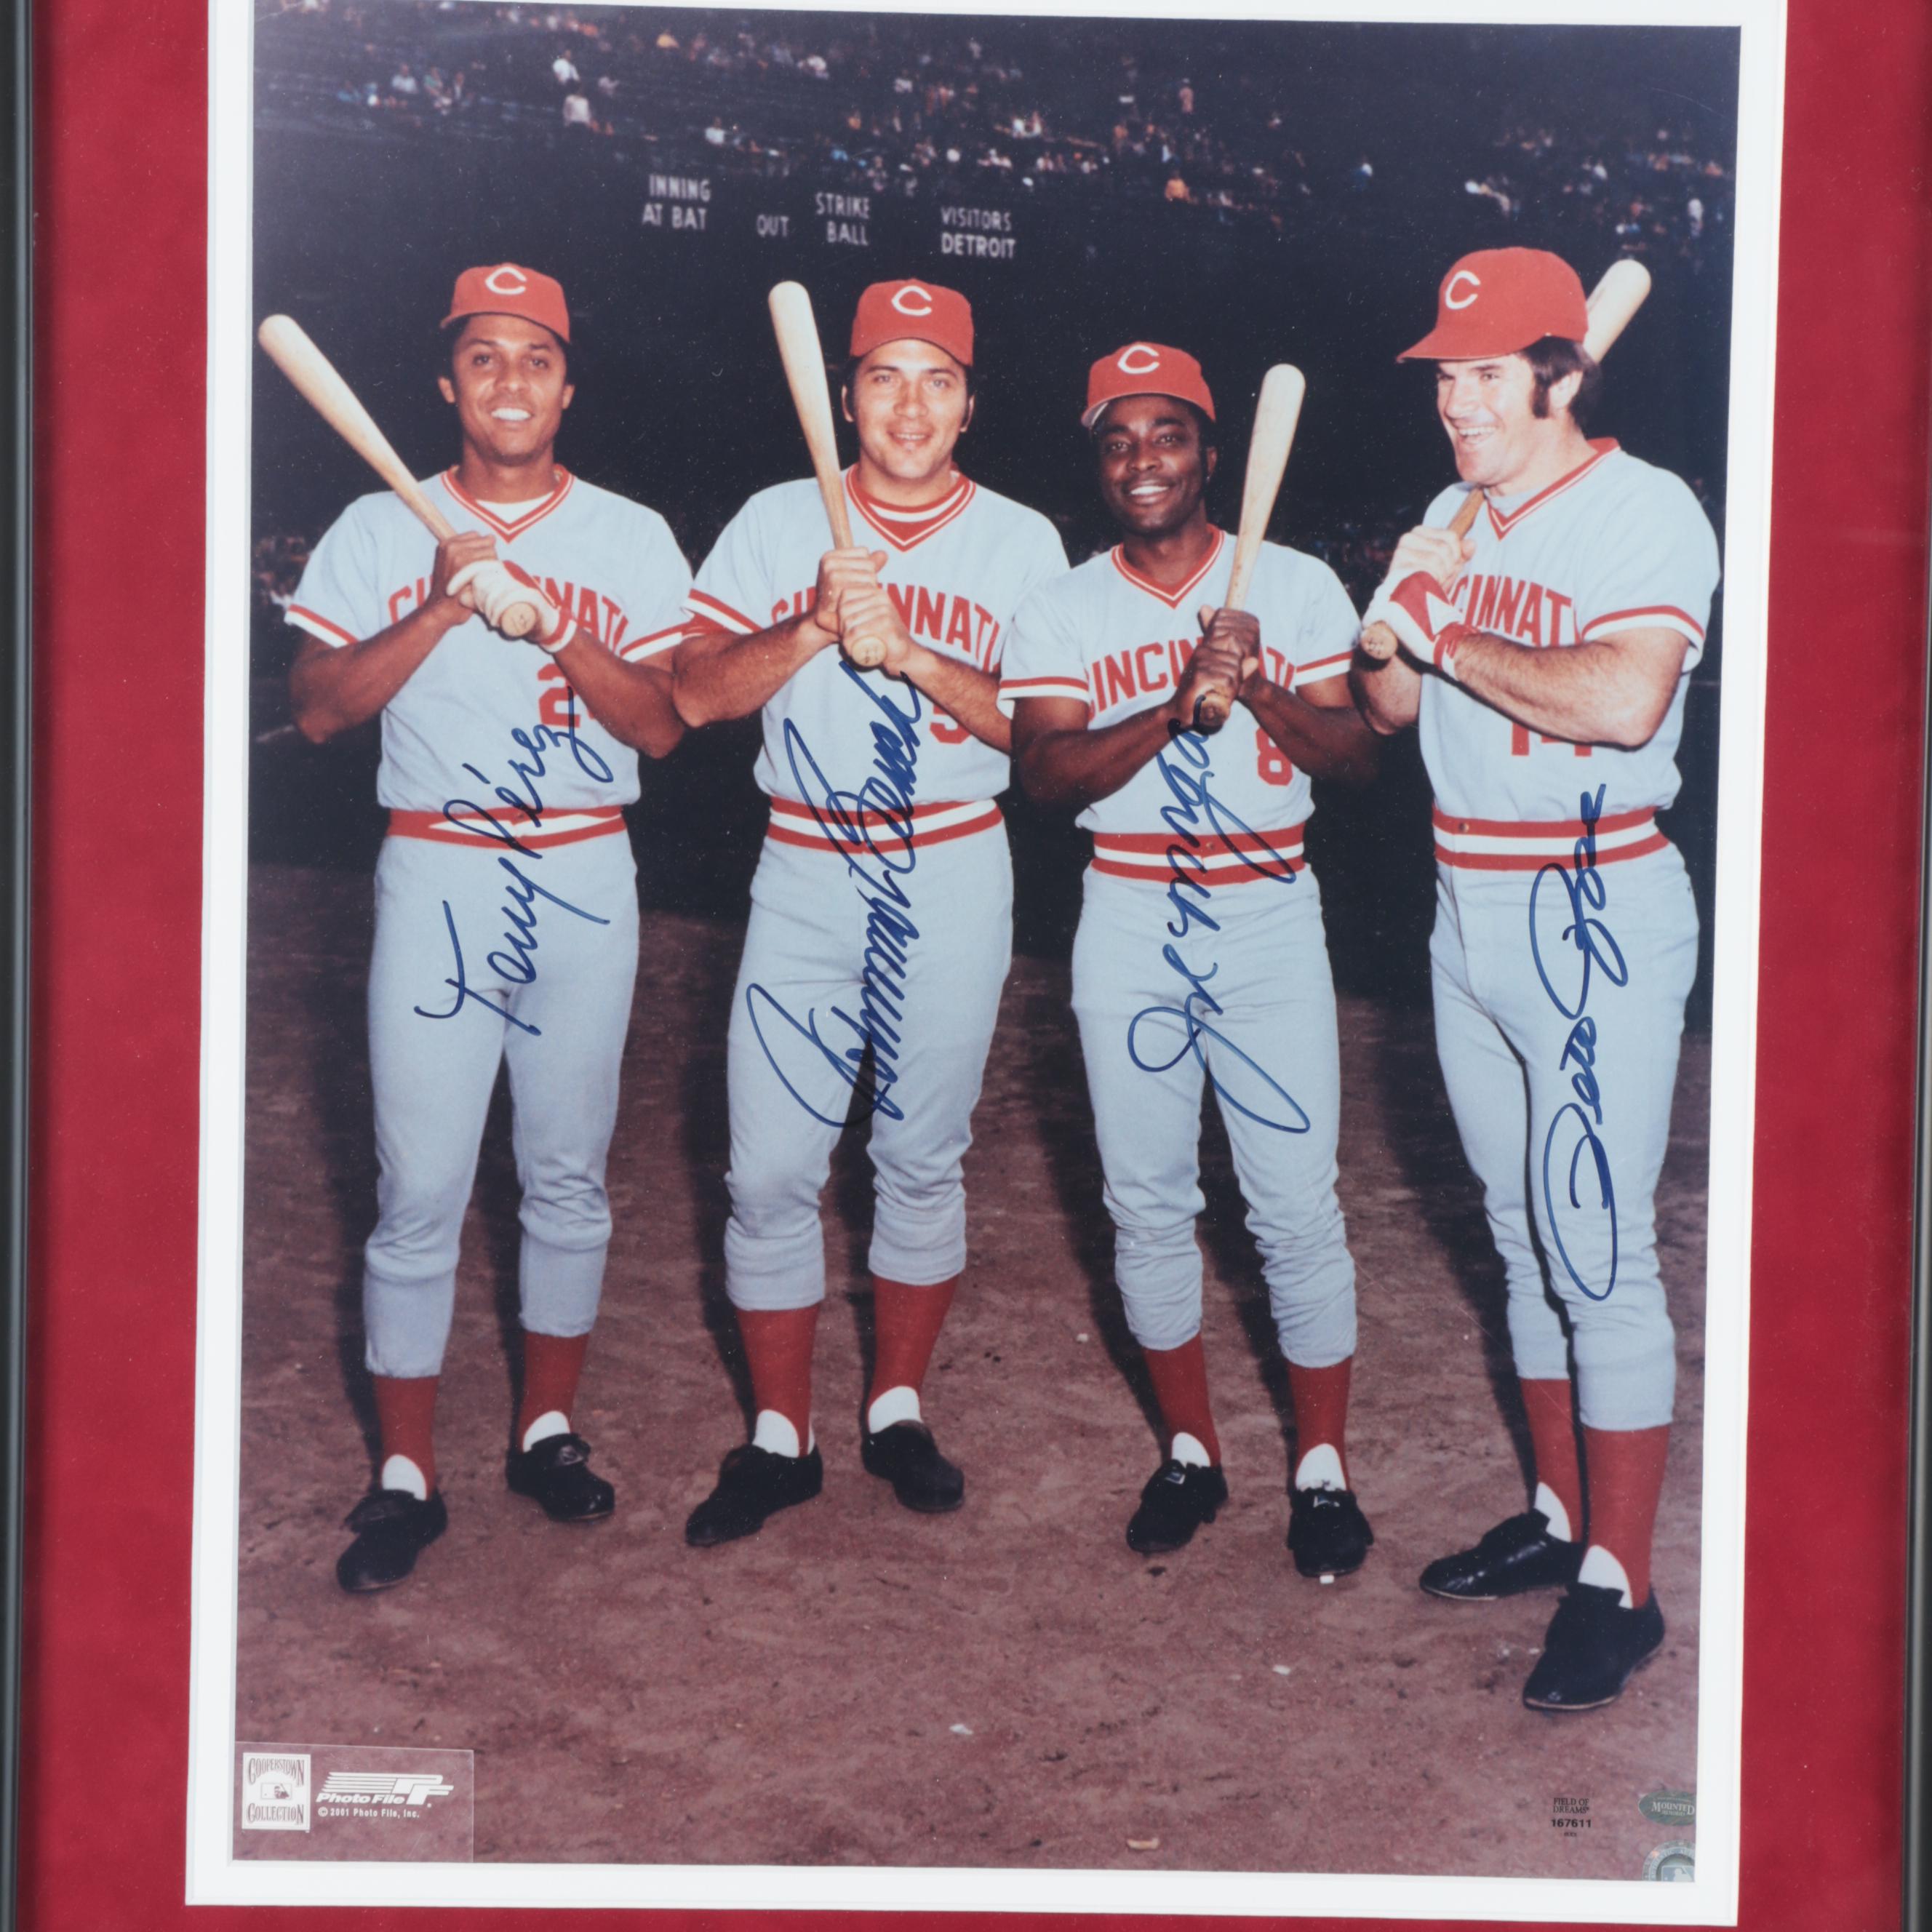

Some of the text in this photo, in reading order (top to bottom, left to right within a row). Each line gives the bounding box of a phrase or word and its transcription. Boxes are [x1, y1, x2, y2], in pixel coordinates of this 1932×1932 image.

[649, 173, 711, 202] INNING
[642, 203, 706, 230] AT BAT
[815, 191, 870, 219] STRIKE
[756, 214, 789, 237] OUT
[941, 207, 1012, 231] VISITORS
[826, 220, 869, 246] BALL
[941, 232, 1016, 259] DETROIT
[485, 266, 526, 295] C
[1445, 270, 1481, 309] C
[891, 284, 933, 316] C
[1117, 344, 1159, 374] C
[1256, 727, 1293, 787] 8
[248, 1757, 305, 1787] COOPERSTOWN
[315, 1792, 406, 1805] Photo File
[1553, 1797, 1590, 1806] FIELD OF
[1650, 1800, 1696, 1816] MOUNTED
[247, 1803, 304, 1825] COLLECTION
[330, 1808, 350, 1816] 2001
[353, 1808, 378, 1817] Photo
[381, 1808, 400, 1819] File,
[403, 1809, 420, 1818] Inc.
[1551, 1818, 1592, 1828] 167611
